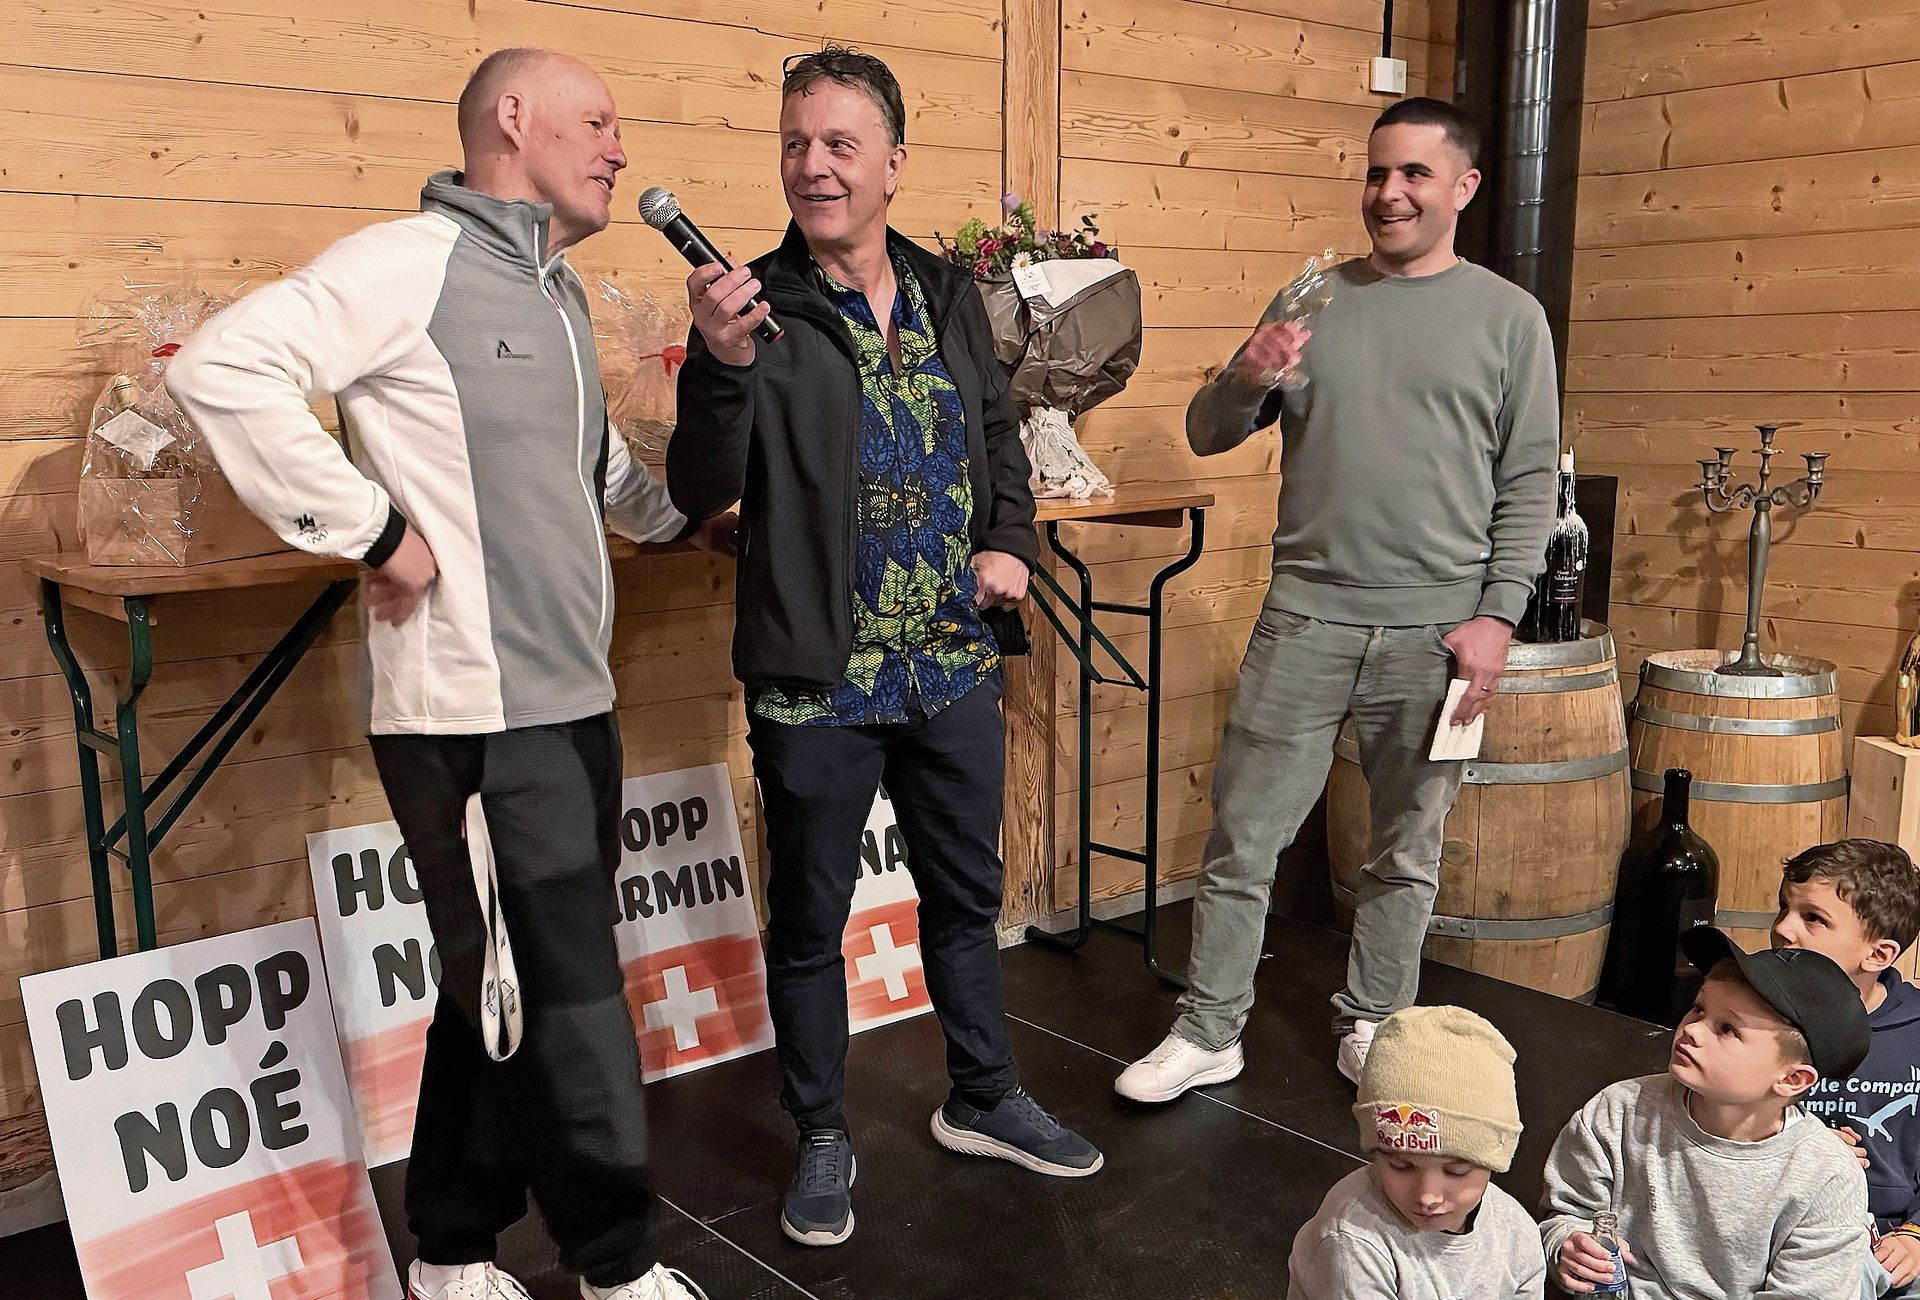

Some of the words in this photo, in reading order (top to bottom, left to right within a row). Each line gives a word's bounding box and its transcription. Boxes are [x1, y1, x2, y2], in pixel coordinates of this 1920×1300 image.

[620, 796, 709, 853] OPP
[856, 823, 909, 880] NA
[331, 842, 425, 918] HO
[619, 855, 745, 923] RMIN
[55, 950, 310, 1081] HOPP
[113, 1040, 310, 1194] NOÉ
[1808, 1077, 1841, 1097] yle
[1376, 1129, 1405, 1149] Red
[1407, 1133, 1438, 1150] Bull
